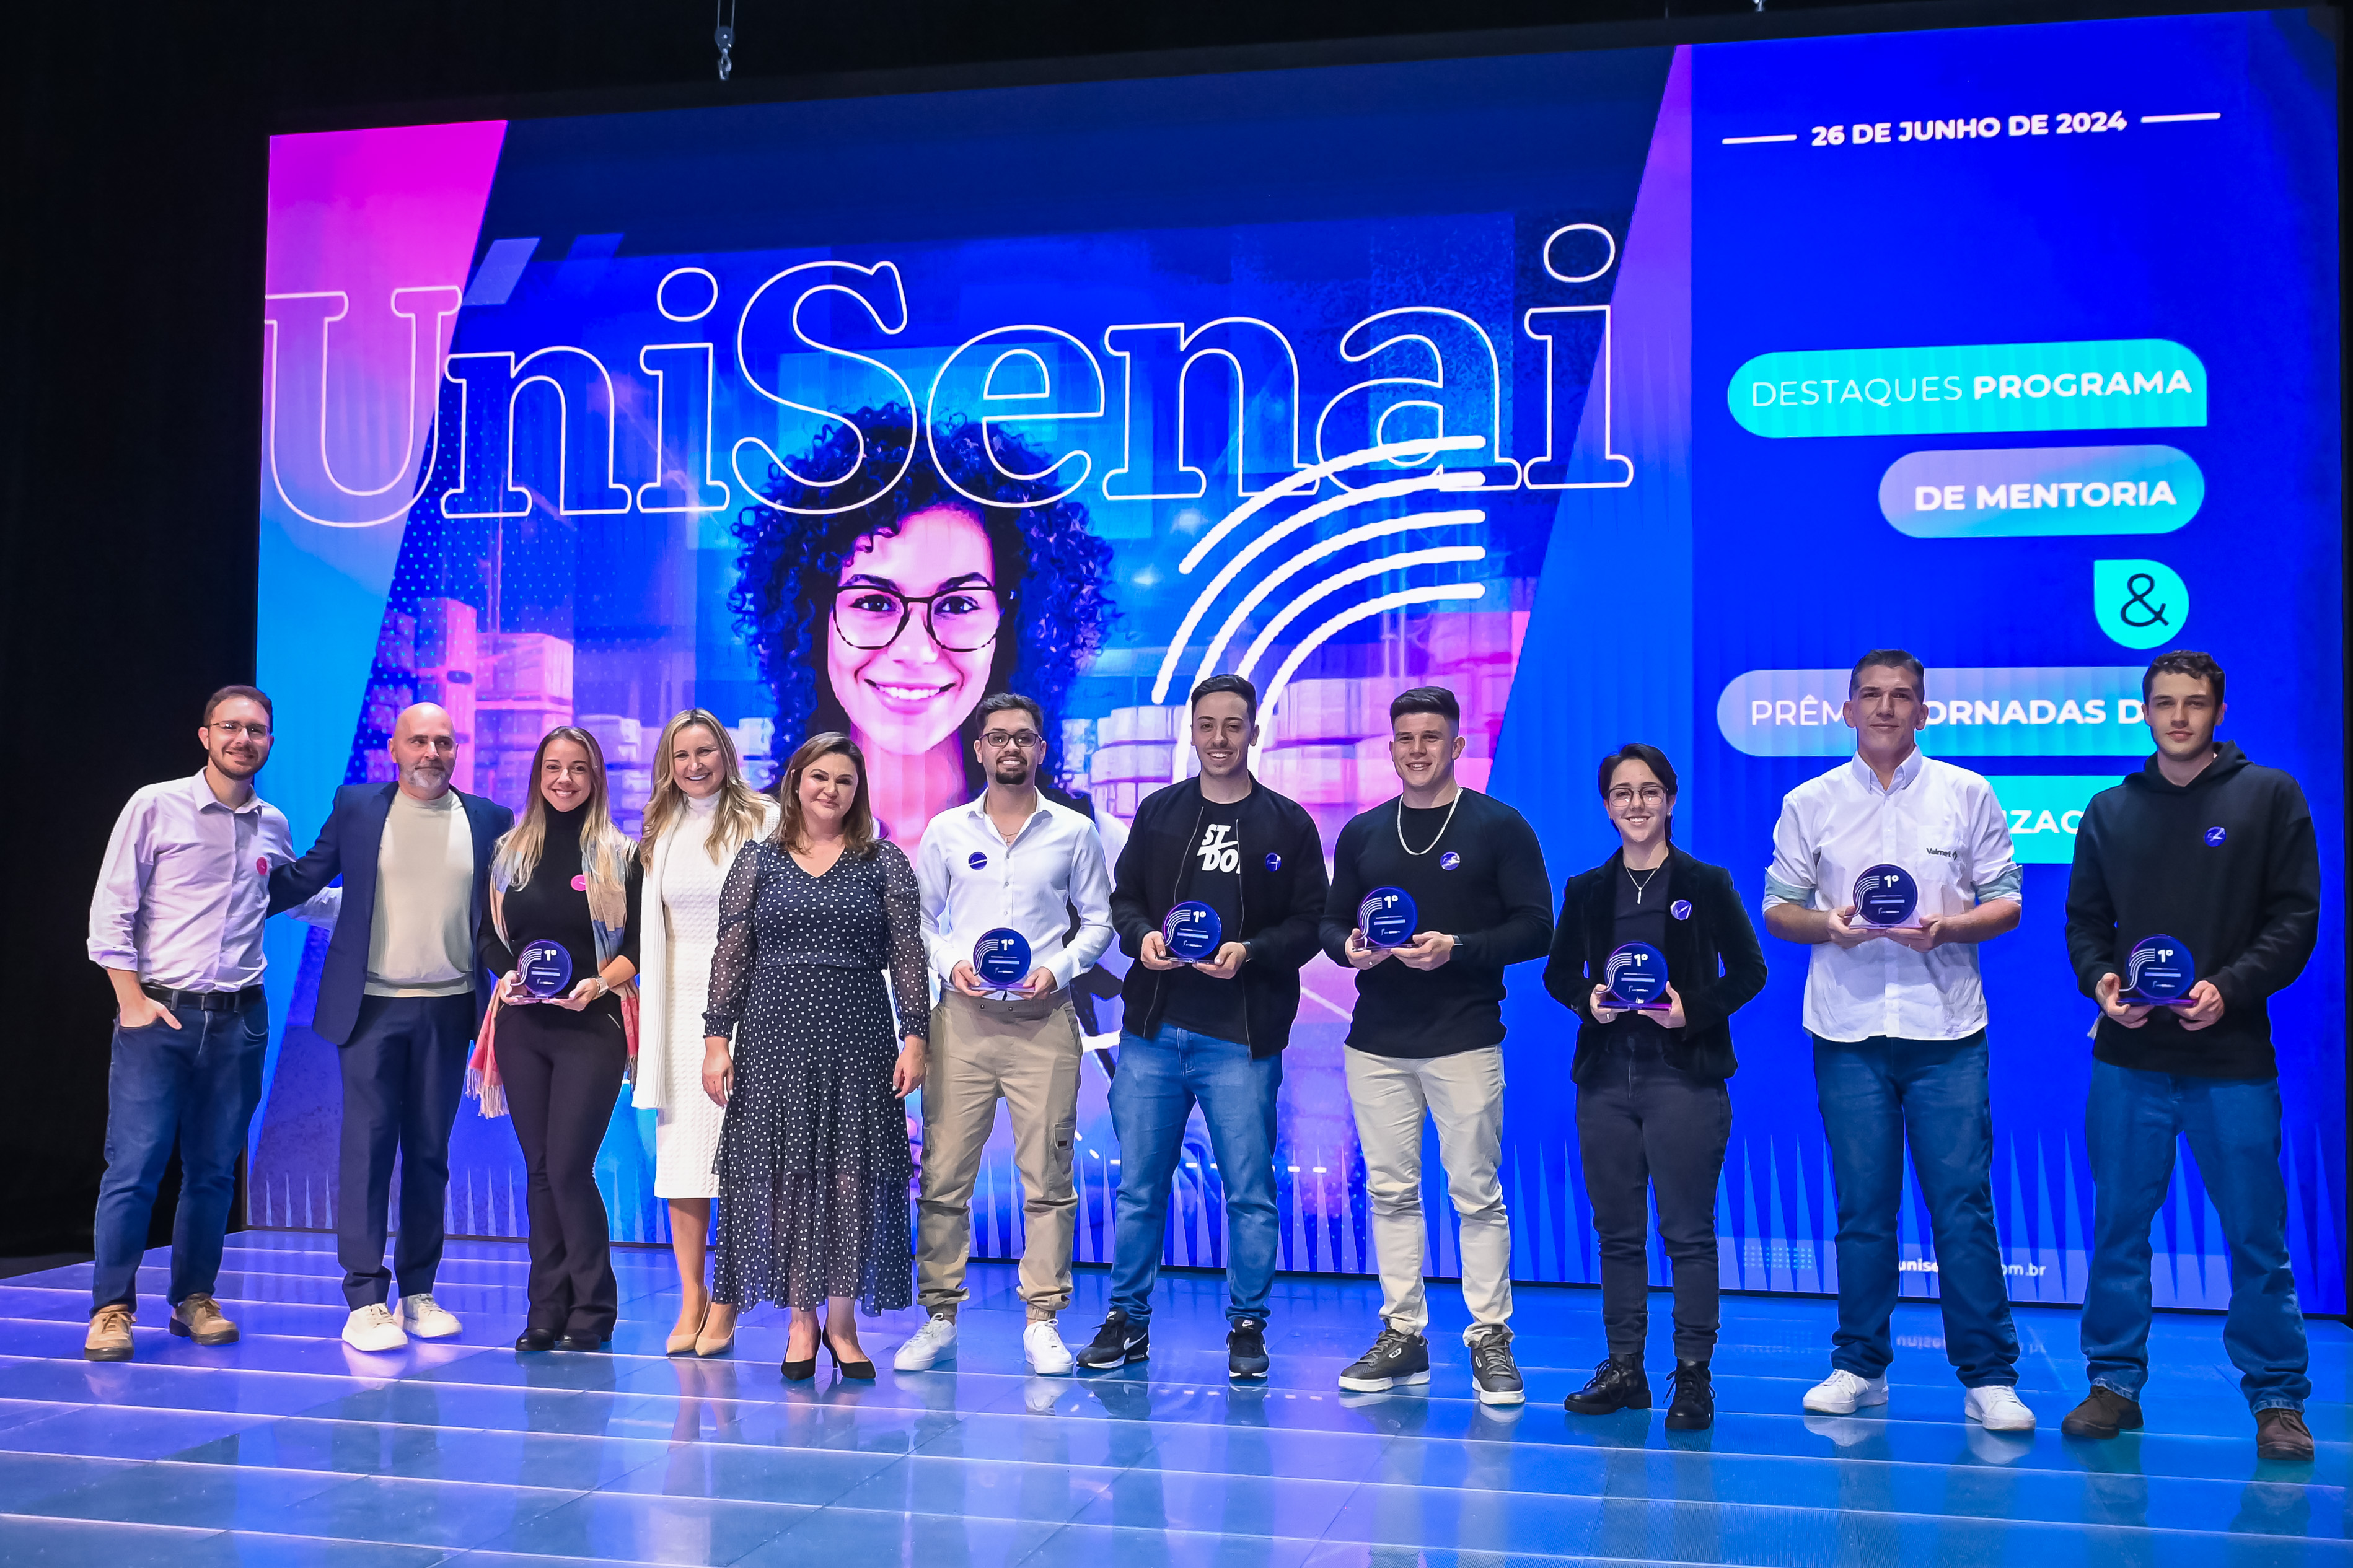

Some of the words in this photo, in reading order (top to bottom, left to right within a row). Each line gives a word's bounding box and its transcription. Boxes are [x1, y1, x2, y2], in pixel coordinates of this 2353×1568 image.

[1811, 125, 1845, 146] 26
[1852, 123, 1891, 144] DE
[1898, 117, 2001, 142] JUNHO
[2008, 114, 2049, 136] DE
[2056, 110, 2127, 133] 2024
[263, 223, 1634, 527] UniSenai
[1752, 375, 1963, 406] DESTAQUES
[1974, 370, 2194, 399] PROGRAMA
[1915, 484, 1966, 510] DE
[1977, 481, 2176, 509] MENTORIA
[2120, 573, 2169, 628] &
[1751, 694, 1844, 725] PRÊM
[1923, 699, 2106, 725] ORNADAS
[2118, 699, 2144, 724] D
[1197, 846, 1241, 874] DO
[1926, 848, 1951, 858] Valmet
